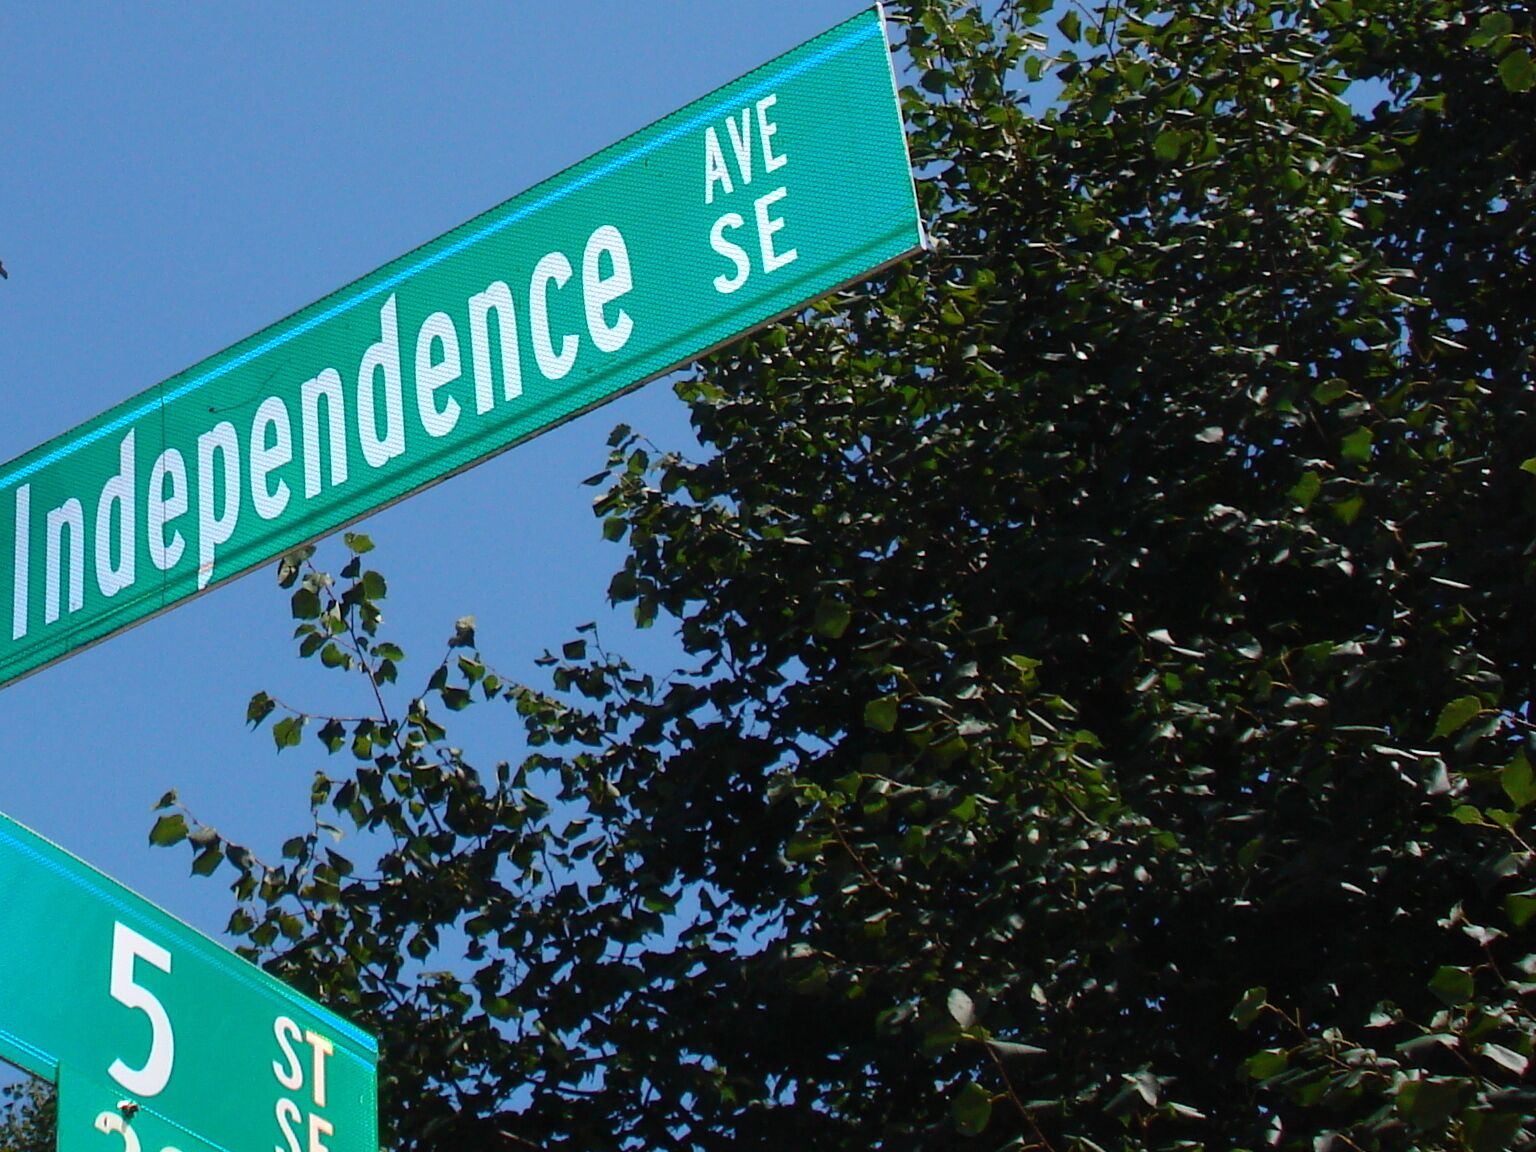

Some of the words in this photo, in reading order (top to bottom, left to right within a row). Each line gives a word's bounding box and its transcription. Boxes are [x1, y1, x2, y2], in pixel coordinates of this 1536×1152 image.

[704, 94, 788, 205] AVE
[710, 186, 798, 294] SE
[12, 225, 634, 640] Independence
[107, 920, 174, 1097] 5
[272, 1015, 334, 1107] ST
